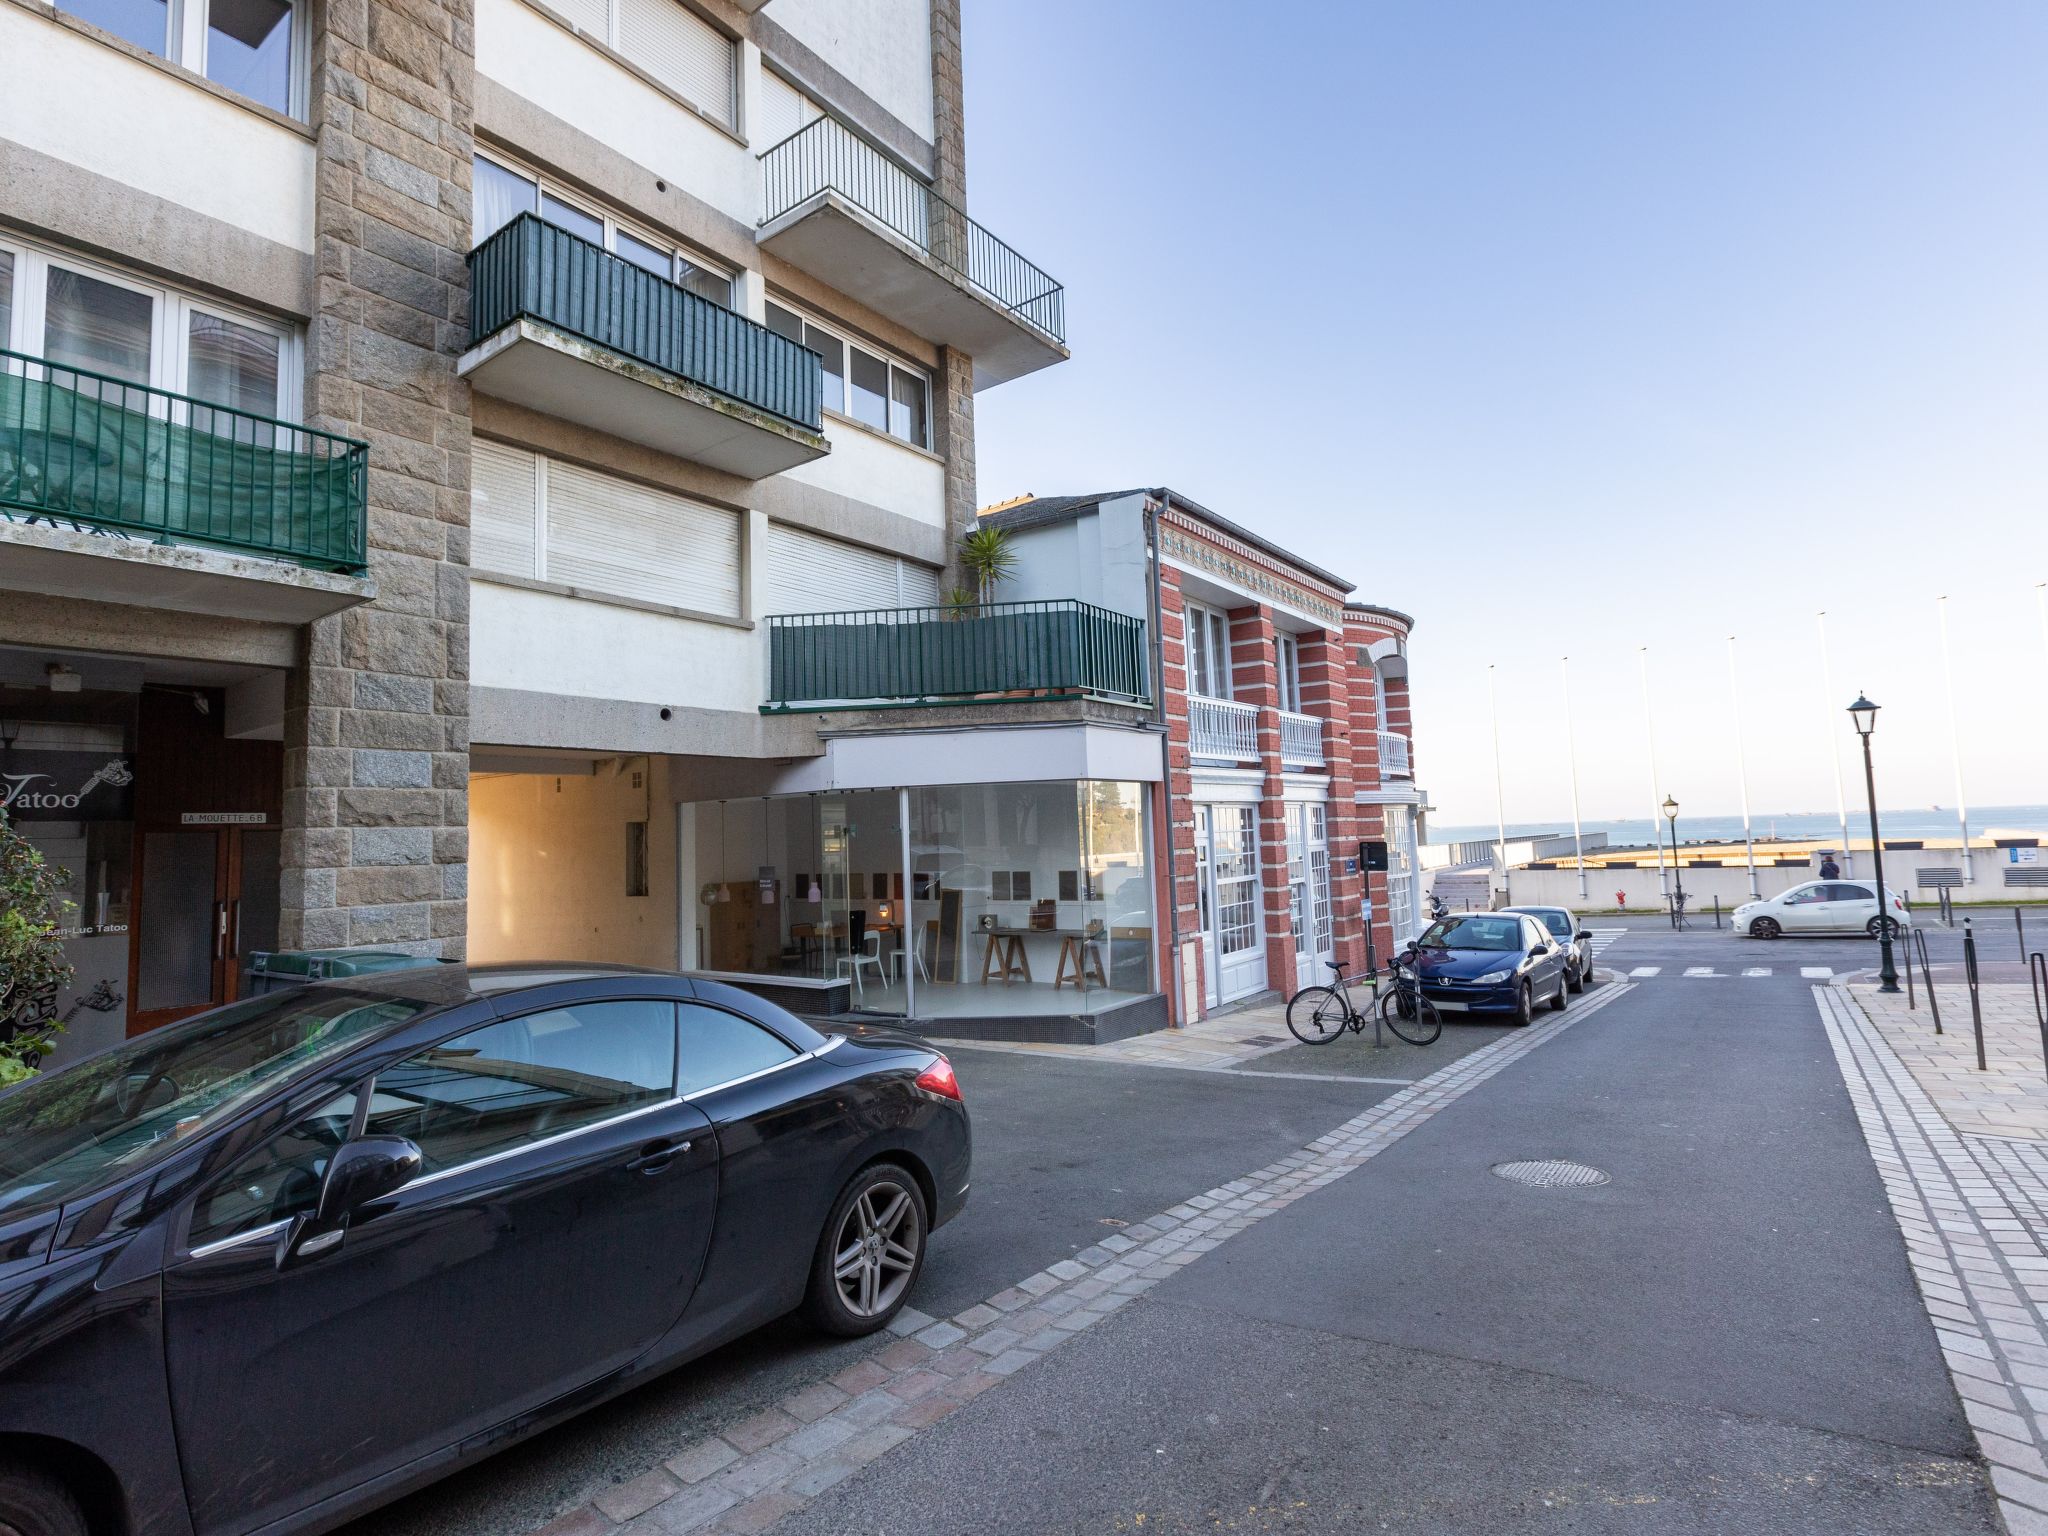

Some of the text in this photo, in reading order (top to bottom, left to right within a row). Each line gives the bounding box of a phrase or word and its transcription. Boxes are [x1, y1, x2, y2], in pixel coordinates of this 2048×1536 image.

[0, 773, 80, 808] Tatoo
[184, 814, 194, 822] LA
[199, 814, 244, 822] MOUETTE
[96, 924, 128, 932] Tatoo
